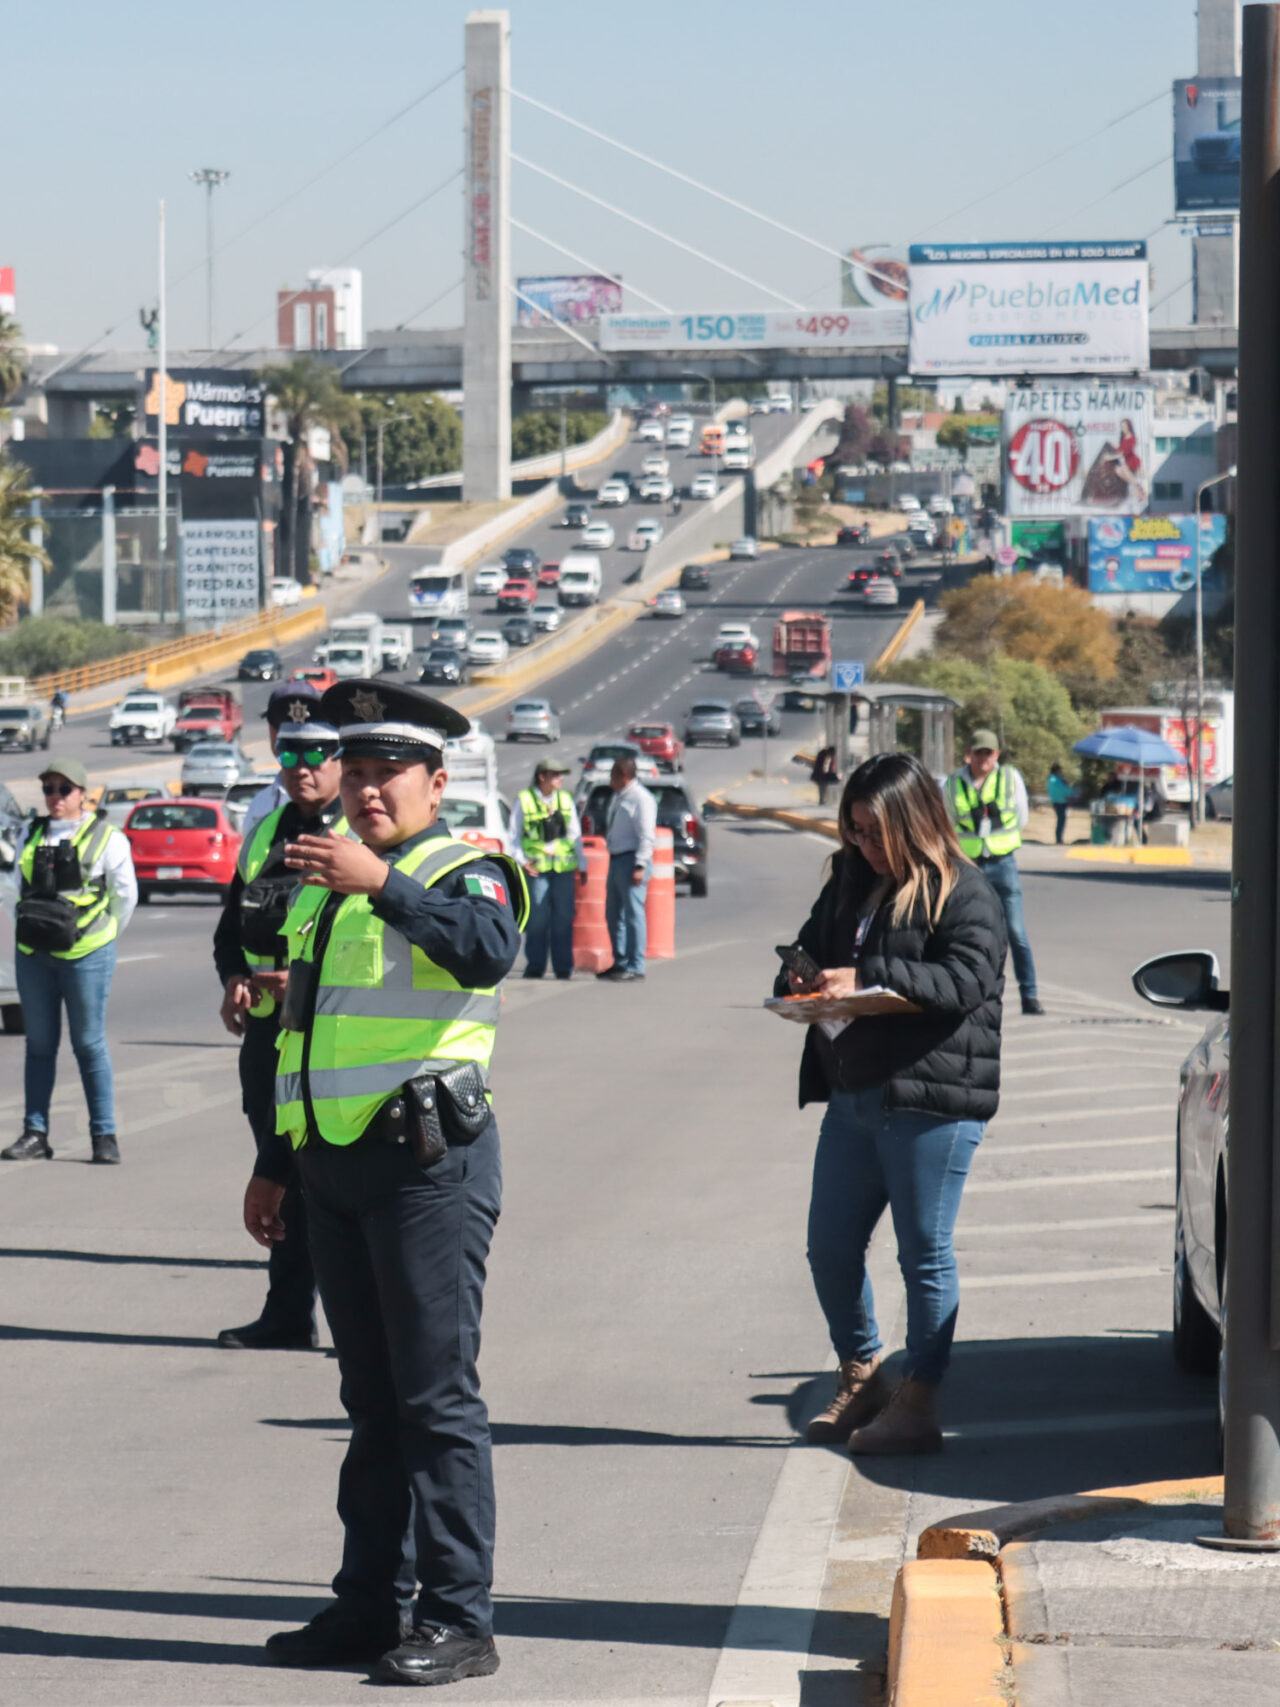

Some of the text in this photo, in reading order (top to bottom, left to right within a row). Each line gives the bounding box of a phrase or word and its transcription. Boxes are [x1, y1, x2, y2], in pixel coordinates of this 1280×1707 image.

[969, 279, 1141, 308] PueblaMed
[680, 316, 734, 341] 150
[796, 316, 849, 336] $499
[186, 381, 261, 403] Mármoles
[1008, 391, 1145, 411] TAPETES HAMID
[185, 402, 260, 427] Puente
[186, 547, 255, 557] CANTERAS
[186, 563, 255, 573] GRANITOS
[187, 579, 255, 590] PIEDRAS
[187, 597, 255, 609] PIZARRAS
